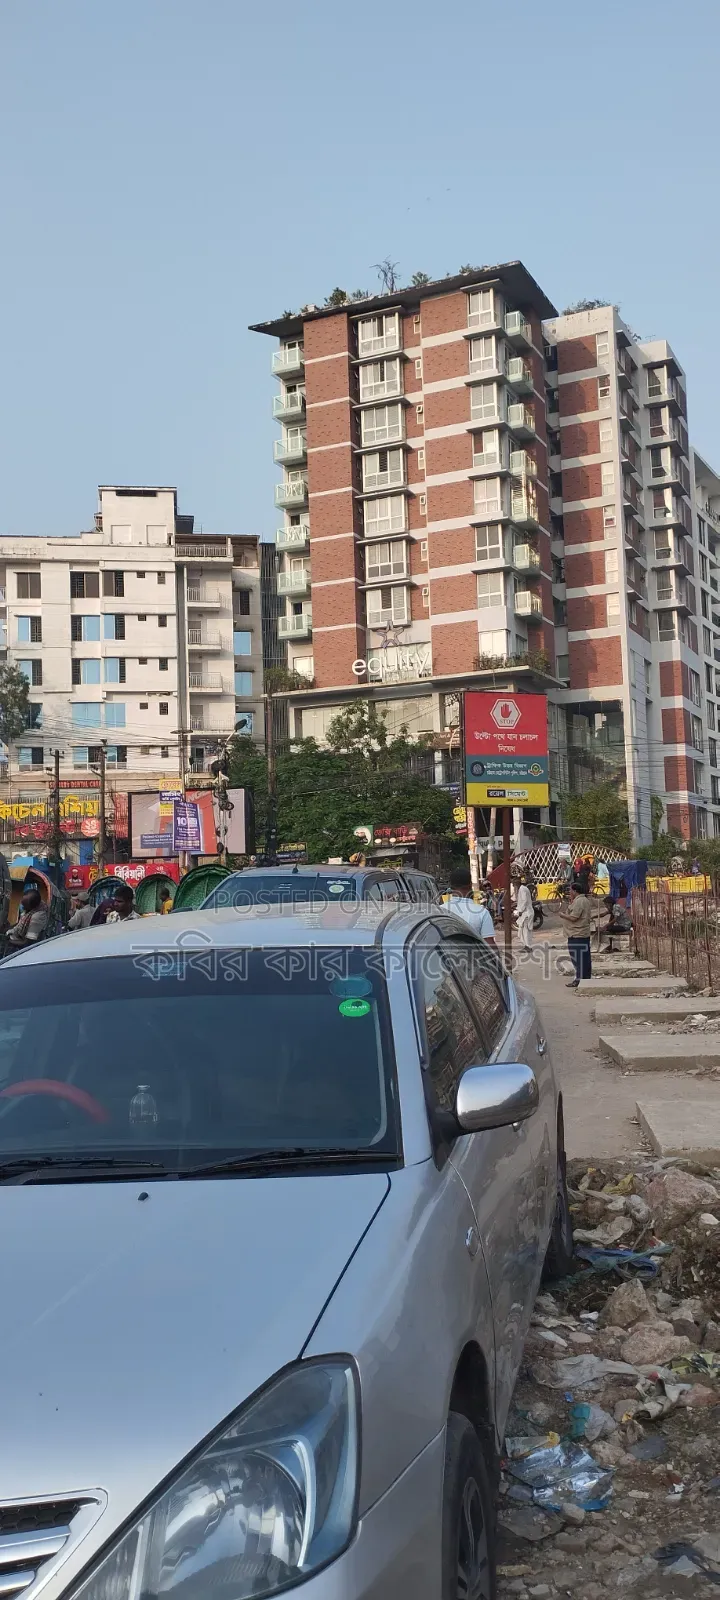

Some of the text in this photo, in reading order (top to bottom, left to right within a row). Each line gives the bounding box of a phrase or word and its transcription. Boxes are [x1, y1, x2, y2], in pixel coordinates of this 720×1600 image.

[351, 650, 430, 678] equity
[474, 731, 539, 741] উল্টো পথে যান চলাচল
[498, 744, 516, 753] নিষেধ
[114, 865, 145, 881] বিরিয়ানী
